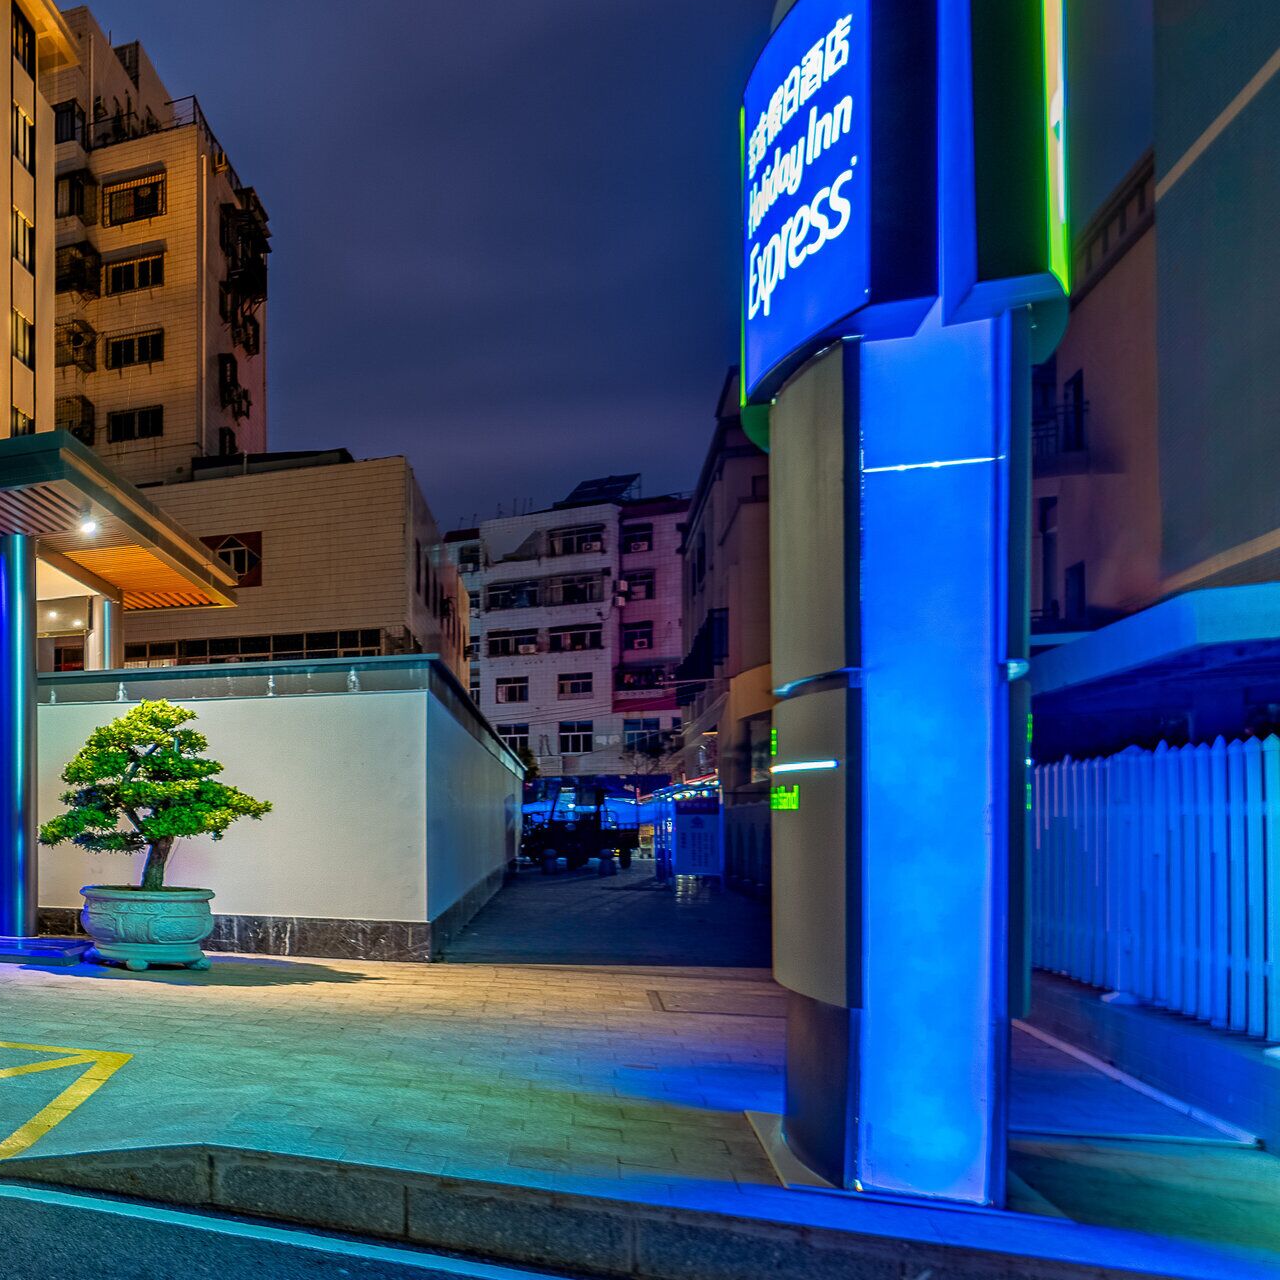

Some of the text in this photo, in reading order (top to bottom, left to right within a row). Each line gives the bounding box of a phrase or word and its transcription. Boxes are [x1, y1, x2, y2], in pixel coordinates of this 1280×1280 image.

[749, 95, 853, 239] Holiday Inn
[749, 169, 853, 320] Express
